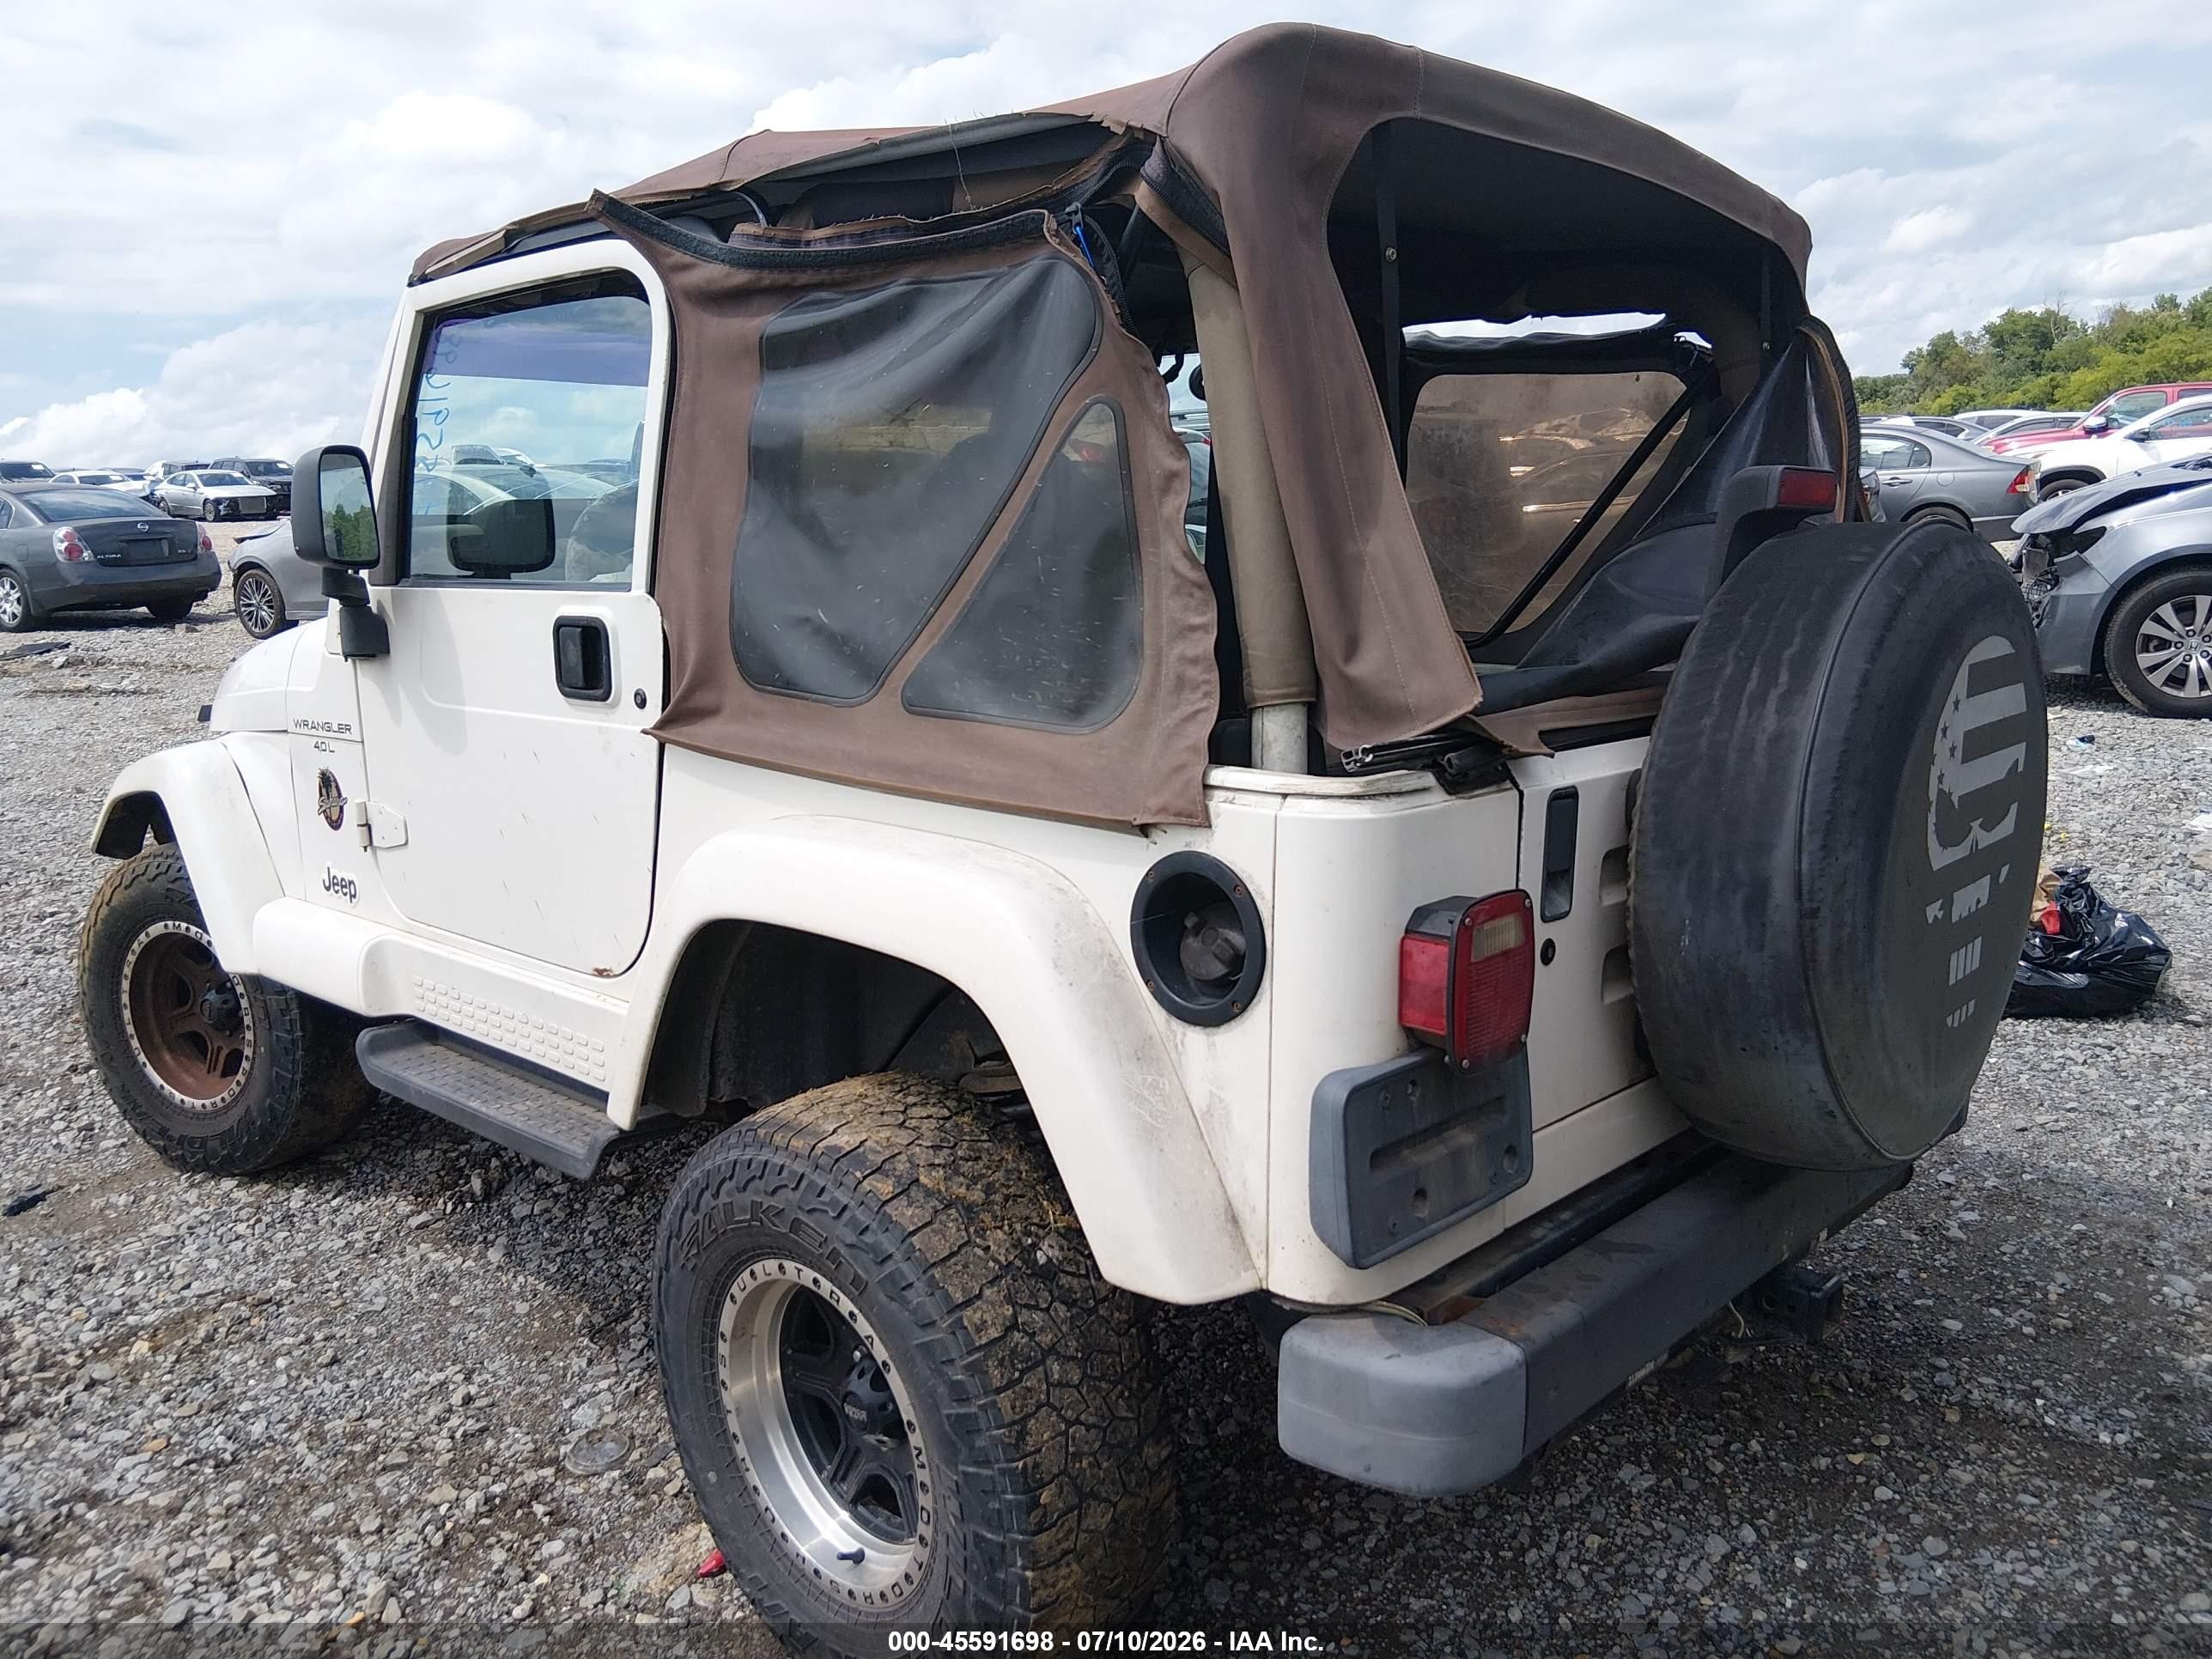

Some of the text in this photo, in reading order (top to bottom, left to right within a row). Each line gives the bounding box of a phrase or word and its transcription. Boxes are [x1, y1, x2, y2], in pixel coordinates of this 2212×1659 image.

[293, 718, 353, 736] WRANGLER
[322, 866, 357, 904] Jeep
[680, 1199, 868, 1296] FALKEN
